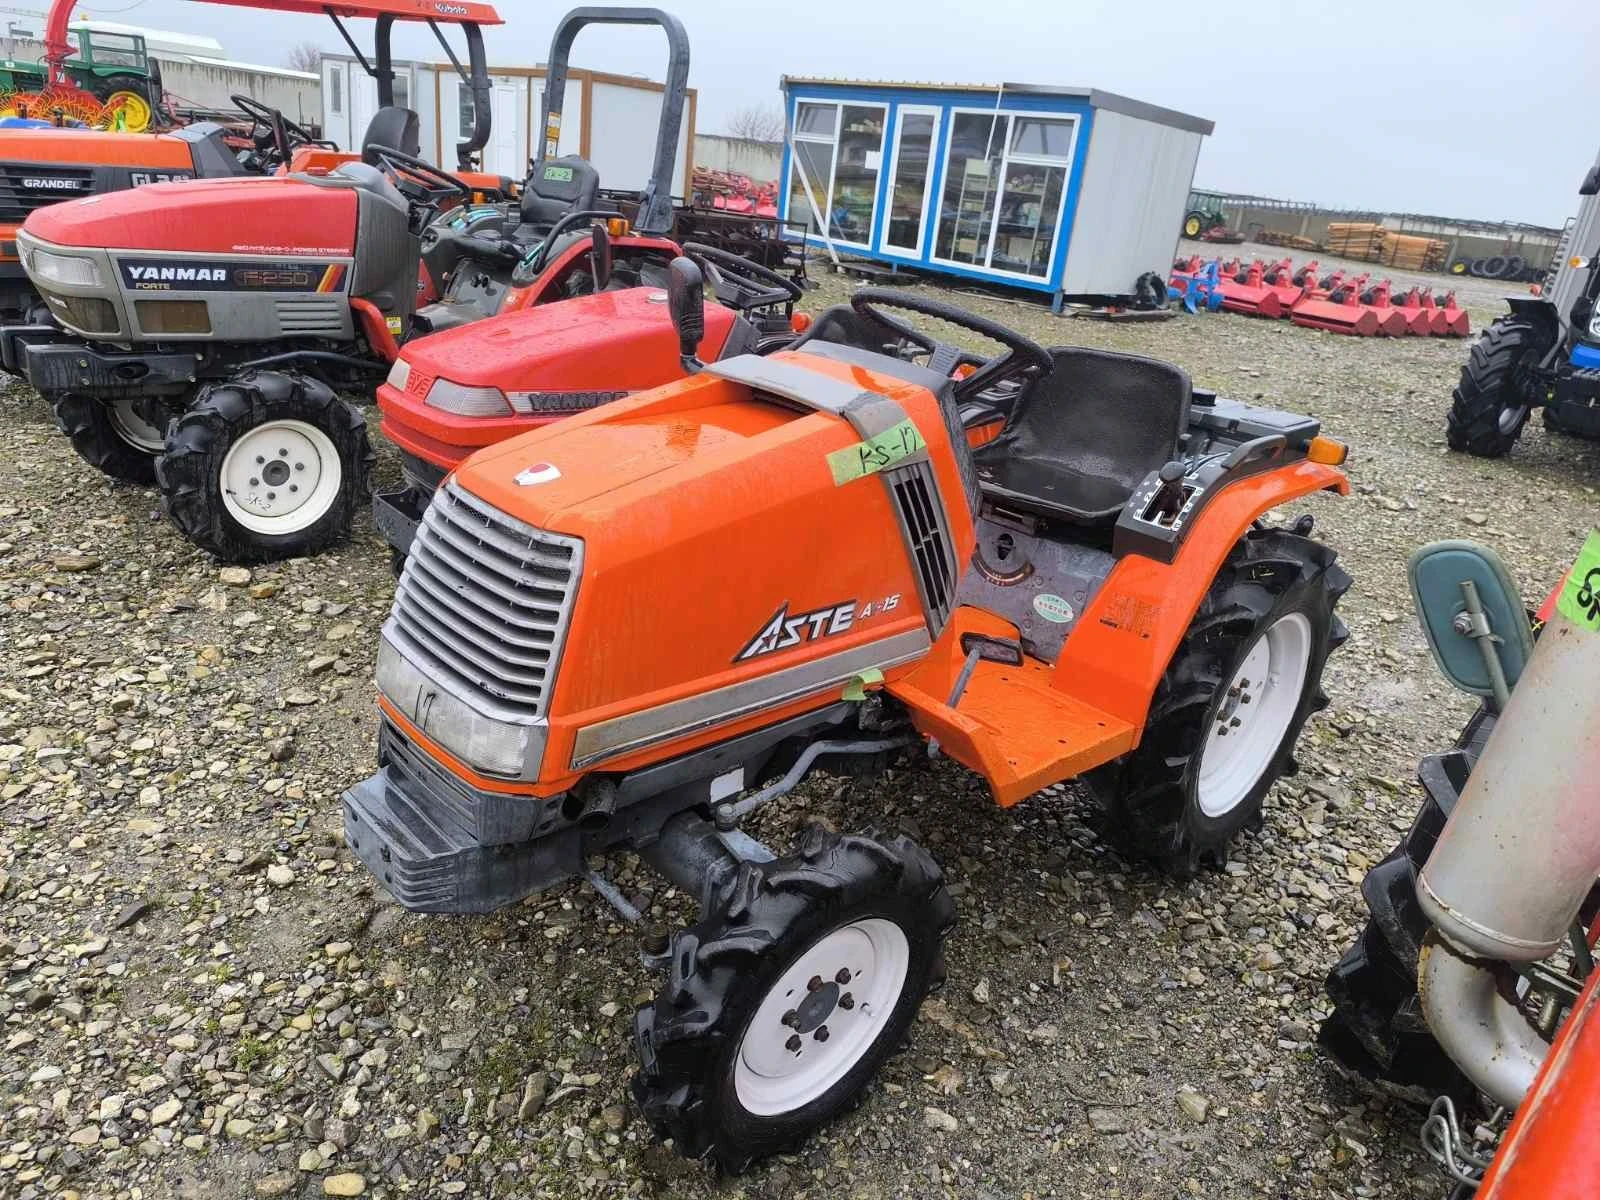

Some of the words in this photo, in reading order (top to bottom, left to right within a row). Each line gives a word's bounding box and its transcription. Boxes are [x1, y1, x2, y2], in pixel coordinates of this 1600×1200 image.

[434, 3, 468, 14] Kubota
[23, 178, 80, 190] GRANDEL
[128, 266, 227, 281] YANMAR
[135, 282, 170, 290] FORTE
[859, 426, 918, 474] KS-17
[731, 600, 857, 663] ASTE
